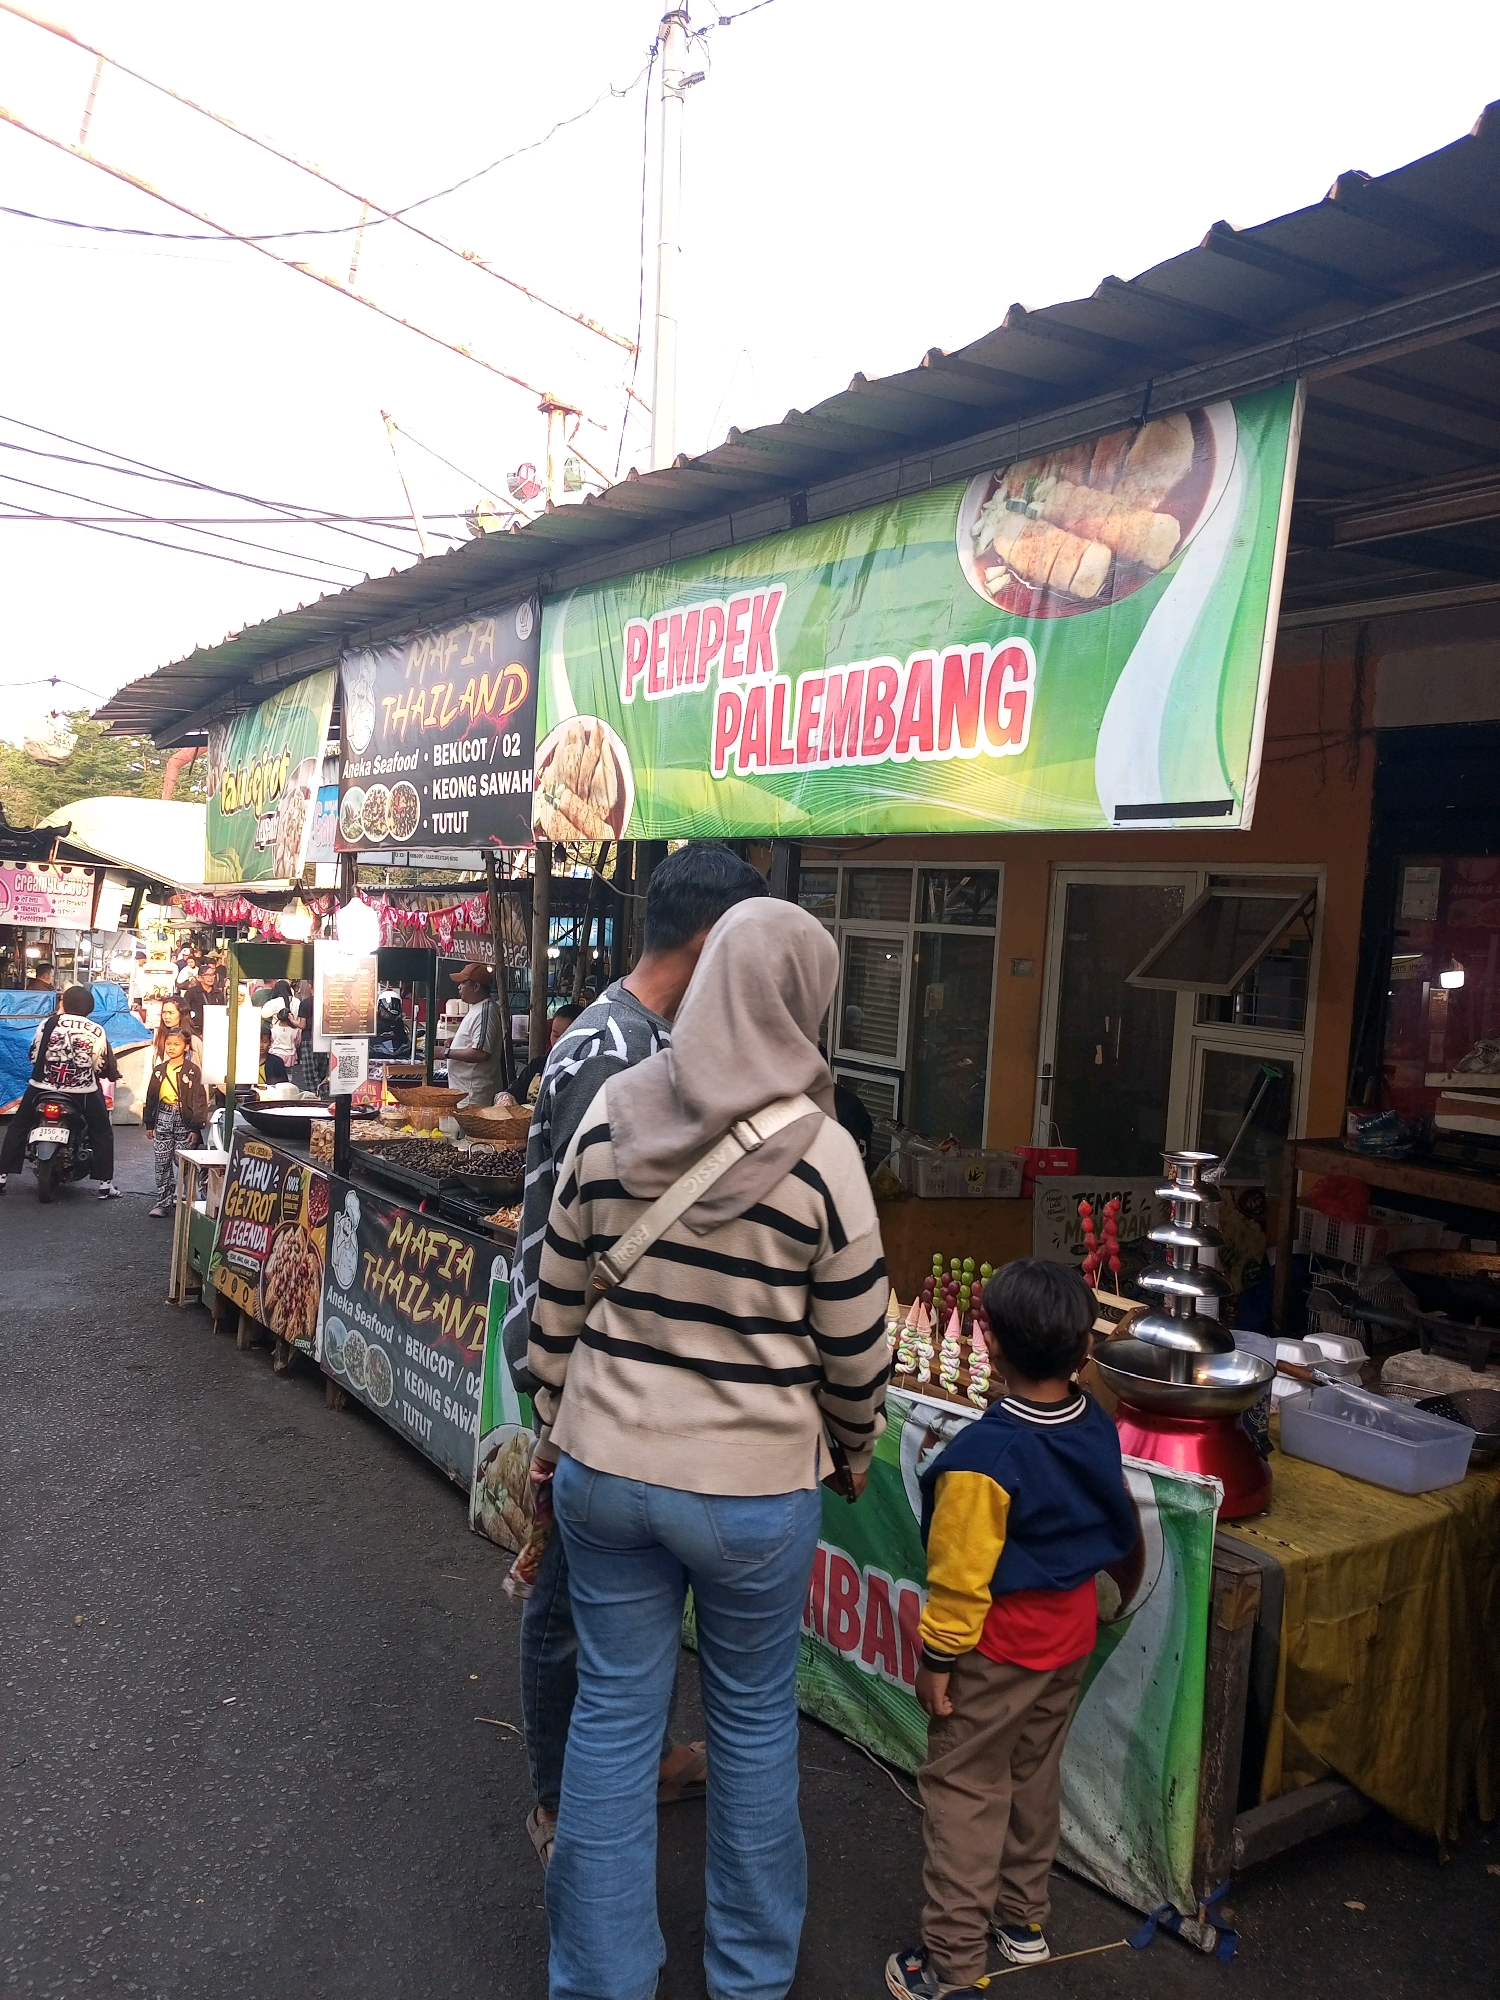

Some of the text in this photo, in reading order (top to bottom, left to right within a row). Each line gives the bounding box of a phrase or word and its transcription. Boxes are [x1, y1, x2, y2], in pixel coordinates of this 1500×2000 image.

[405, 618, 496, 684] MAFIA
[622, 586, 786, 702] PEMPEK
[381, 661, 530, 738] THAILAND
[711, 640, 1034, 776] PALEMBANG
[342, 748, 420, 779] Aneka Seafood
[433, 732, 521, 767] BEKICOT / 02
[432, 768, 533, 800] KEONG SAWAH
[432, 811, 469, 834] TUTUT
[239, 1157, 273, 1192] TAHU
[224, 1179, 278, 1223] GEJROT
[224, 1221, 268, 1254] LEGENDA
[1064, 1215, 1151, 1244] MNOAN
[387, 1216, 475, 1291] MAFIA
[326, 1284, 394, 1344] Aneka Seafood
[404, 1367, 441, 1411] KEONG
[405, 1334, 482, 1400] BEKICOT / 02
[402, 1399, 433, 1441] TUTUT
